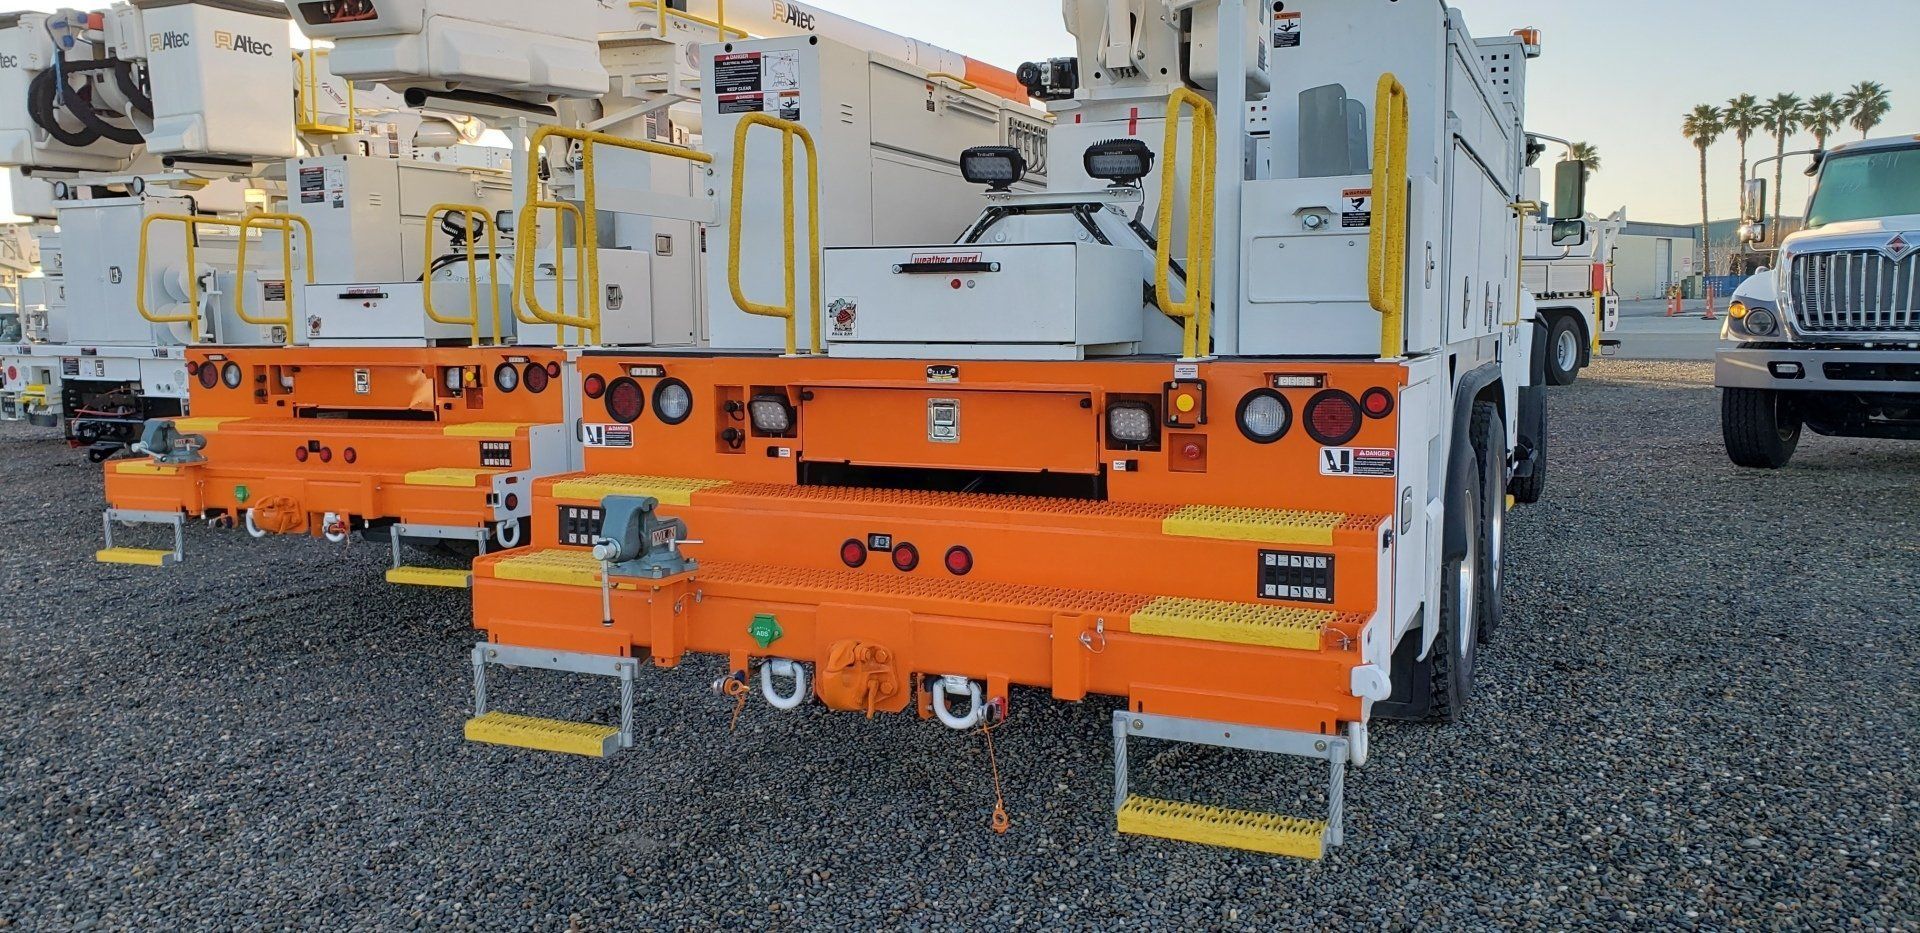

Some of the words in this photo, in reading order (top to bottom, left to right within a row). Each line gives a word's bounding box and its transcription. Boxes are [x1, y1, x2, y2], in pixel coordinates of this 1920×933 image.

[786, 2, 816, 31] Altec
[162, 32, 190, 51] Altec
[233, 34, 273, 57] Altec
[914, 255, 950, 264] weather
